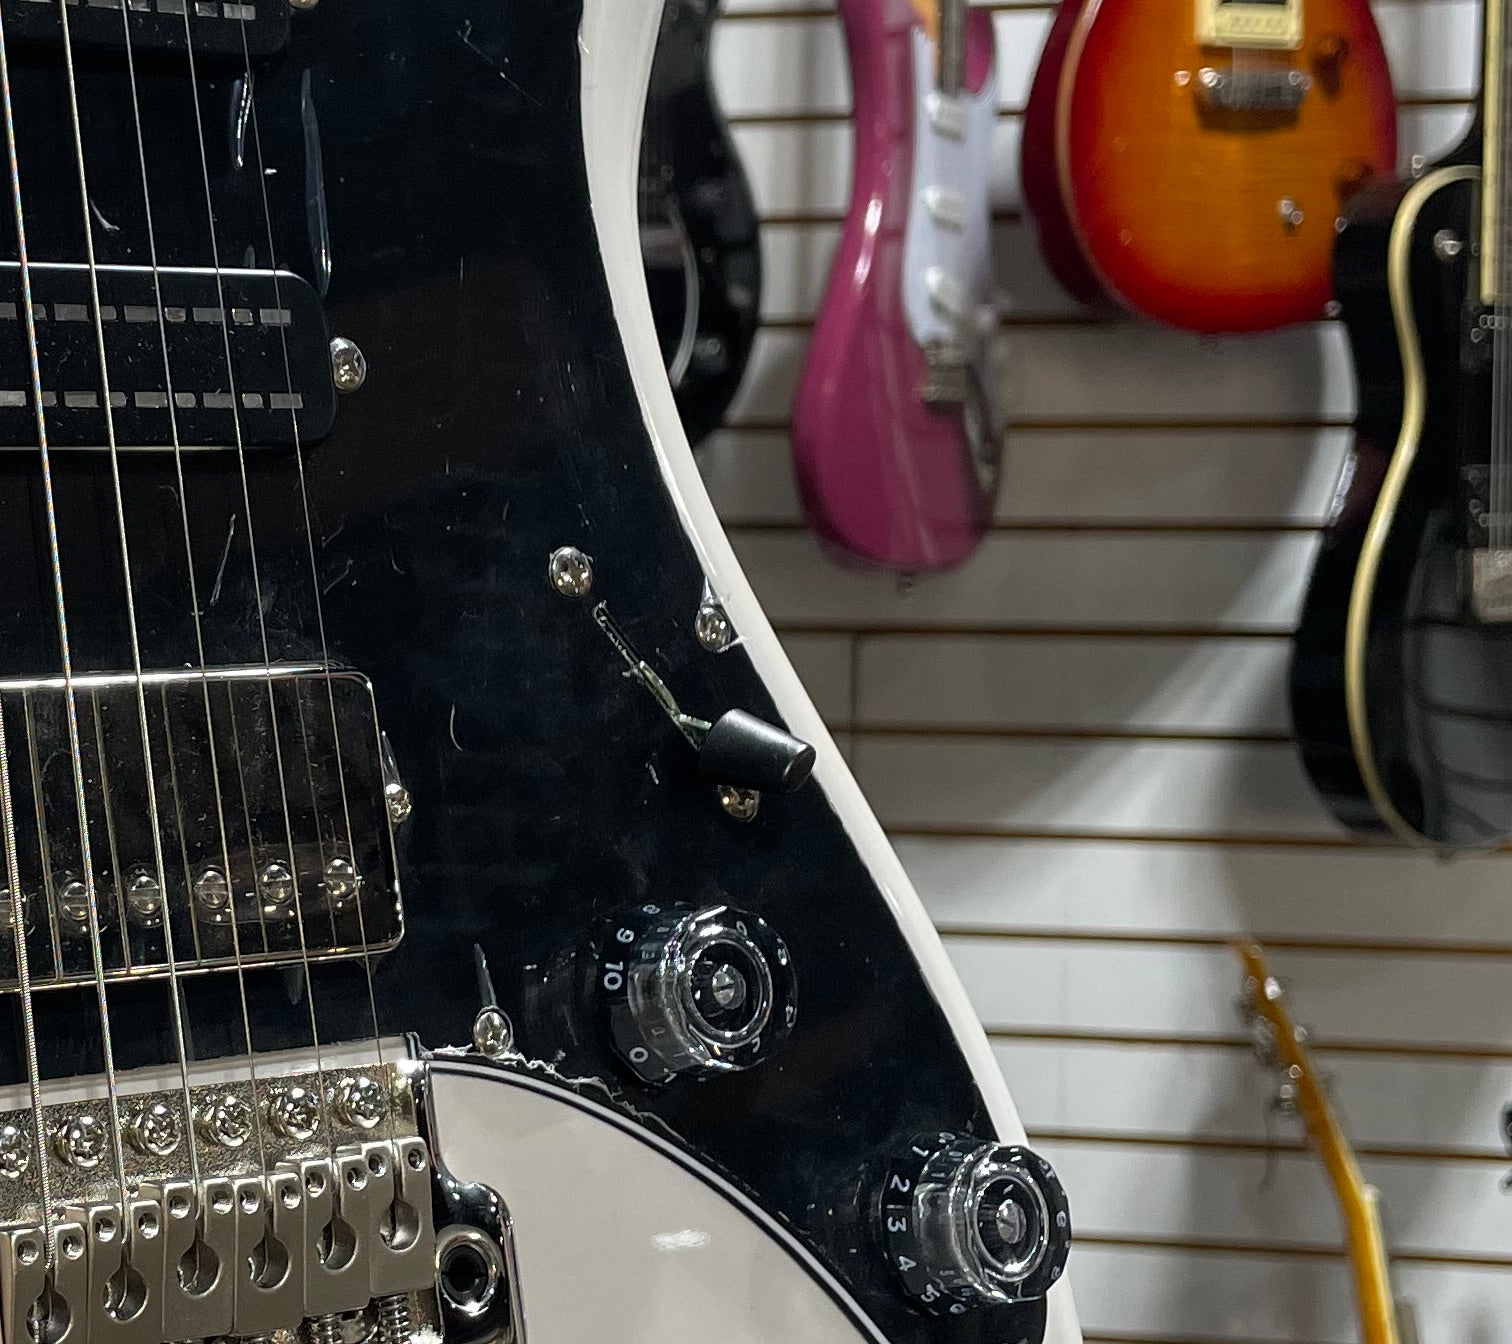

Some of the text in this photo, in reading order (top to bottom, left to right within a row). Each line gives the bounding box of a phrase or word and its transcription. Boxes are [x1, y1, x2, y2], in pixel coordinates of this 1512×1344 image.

[616, 927, 635, 944] 9
[603, 960, 624, 991] 10
[628, 1046, 649, 1063] 0
[890, 1174, 910, 1193] 2
[887, 1216, 907, 1233] 3
[898, 1255, 918, 1272] 4
[920, 1283, 941, 1303] 5
